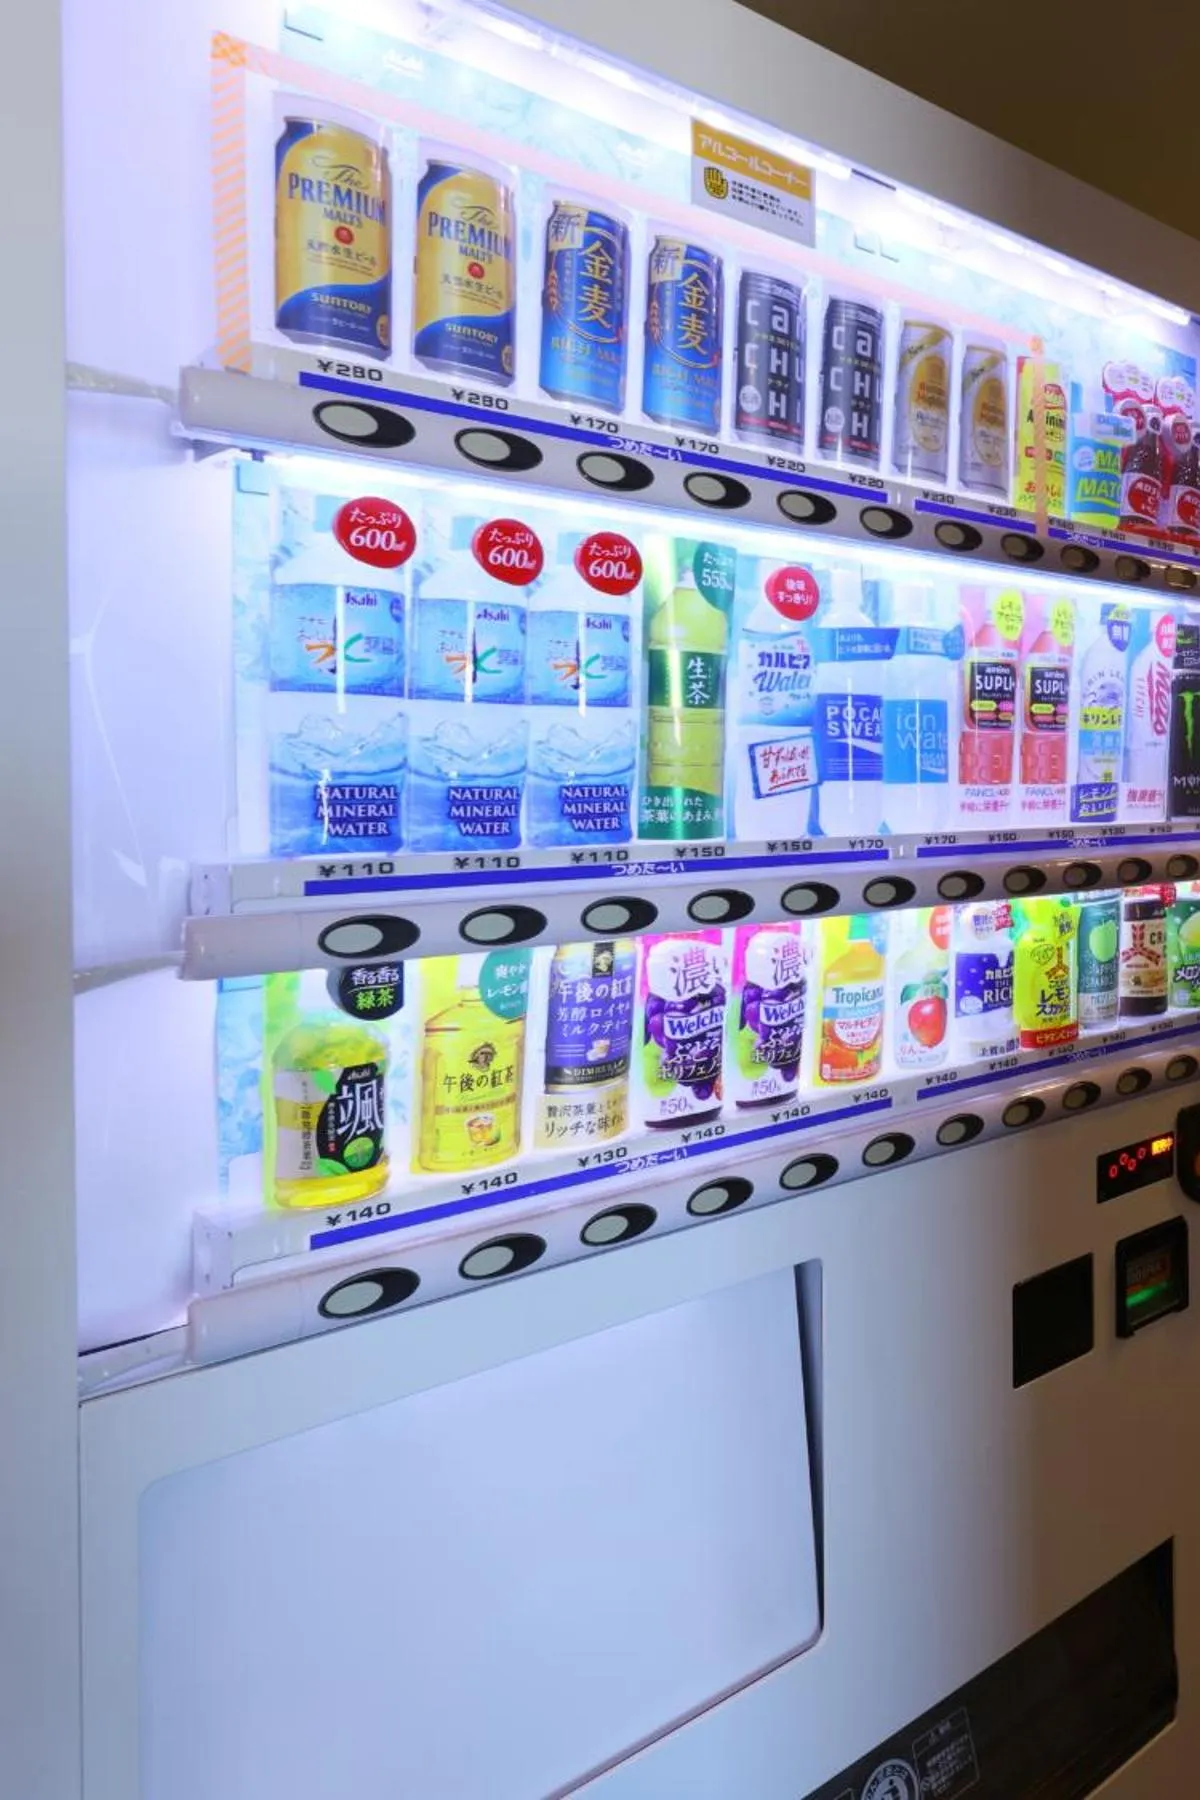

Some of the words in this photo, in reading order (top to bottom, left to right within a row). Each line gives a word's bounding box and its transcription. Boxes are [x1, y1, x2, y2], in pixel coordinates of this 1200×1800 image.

[323, 207, 364, 229] MALTS
[551, 212, 581, 243] 新
[459, 245, 494, 265] MALTS
[653, 247, 682, 275] 新
[578, 241, 614, 329] 金麦
[311, 292, 372, 315] SUNTORY
[678, 272, 710, 355] 金麦
[445, 322, 499, 343] SUNTORY
[317, 359, 383, 383] ¥280
[452, 388, 510, 412] ¥280
[570, 415, 619, 434] ¥170
[674, 437, 720, 455] ¥170
[767, 455, 806, 473] ¥220
[849, 473, 885, 490] ¥220
[349, 506, 402, 528] たっぷり
[488, 527, 535, 548] たっぷり
[588, 541, 632, 559] たっぷり
[345, 591, 379, 608] Asahi
[476, 607, 511, 623] Asahi
[585, 617, 613, 632] Asahi
[686, 657, 710, 706] 生茶
[316, 784, 399, 801] NATURAL
[448, 786, 520, 802] NATURAL
[560, 784, 629, 801] NATURAL
[316, 803, 397, 819] MINERAL
[449, 803, 518, 819] MINERAL
[562, 801, 628, 816] MINERAL
[328, 820, 390, 838] WATER
[459, 820, 512, 837] WATER
[571, 817, 622, 833] WATER
[766, 840, 813, 853] ¥150
[849, 838, 884, 850] ¥170
[925, 834, 957, 845] ¥170
[571, 849, 630, 865] ¥110
[675, 845, 726, 859] ¥150
[318, 861, 395, 878] ¥110
[454, 856, 521, 871] ¥110
[351, 967, 400, 986] 香る香る
[356, 988, 394, 1011] 緑茶
[667, 1035, 722, 1064] ぶどう
[989, 1058, 1019, 1071] ¥140
[443, 1067, 515, 1095] 午後の紅茶
[925, 1071, 958, 1086] ¥140
[852, 1088, 889, 1104] ¥140
[336, 1083, 380, 1140] 颯
[771, 1105, 811, 1123] ¥140
[681, 1125, 726, 1143] ¥140
[578, 1147, 628, 1168] ¥130
[461, 1171, 519, 1195] ¥140
[326, 1202, 392, 1226] ¥140
